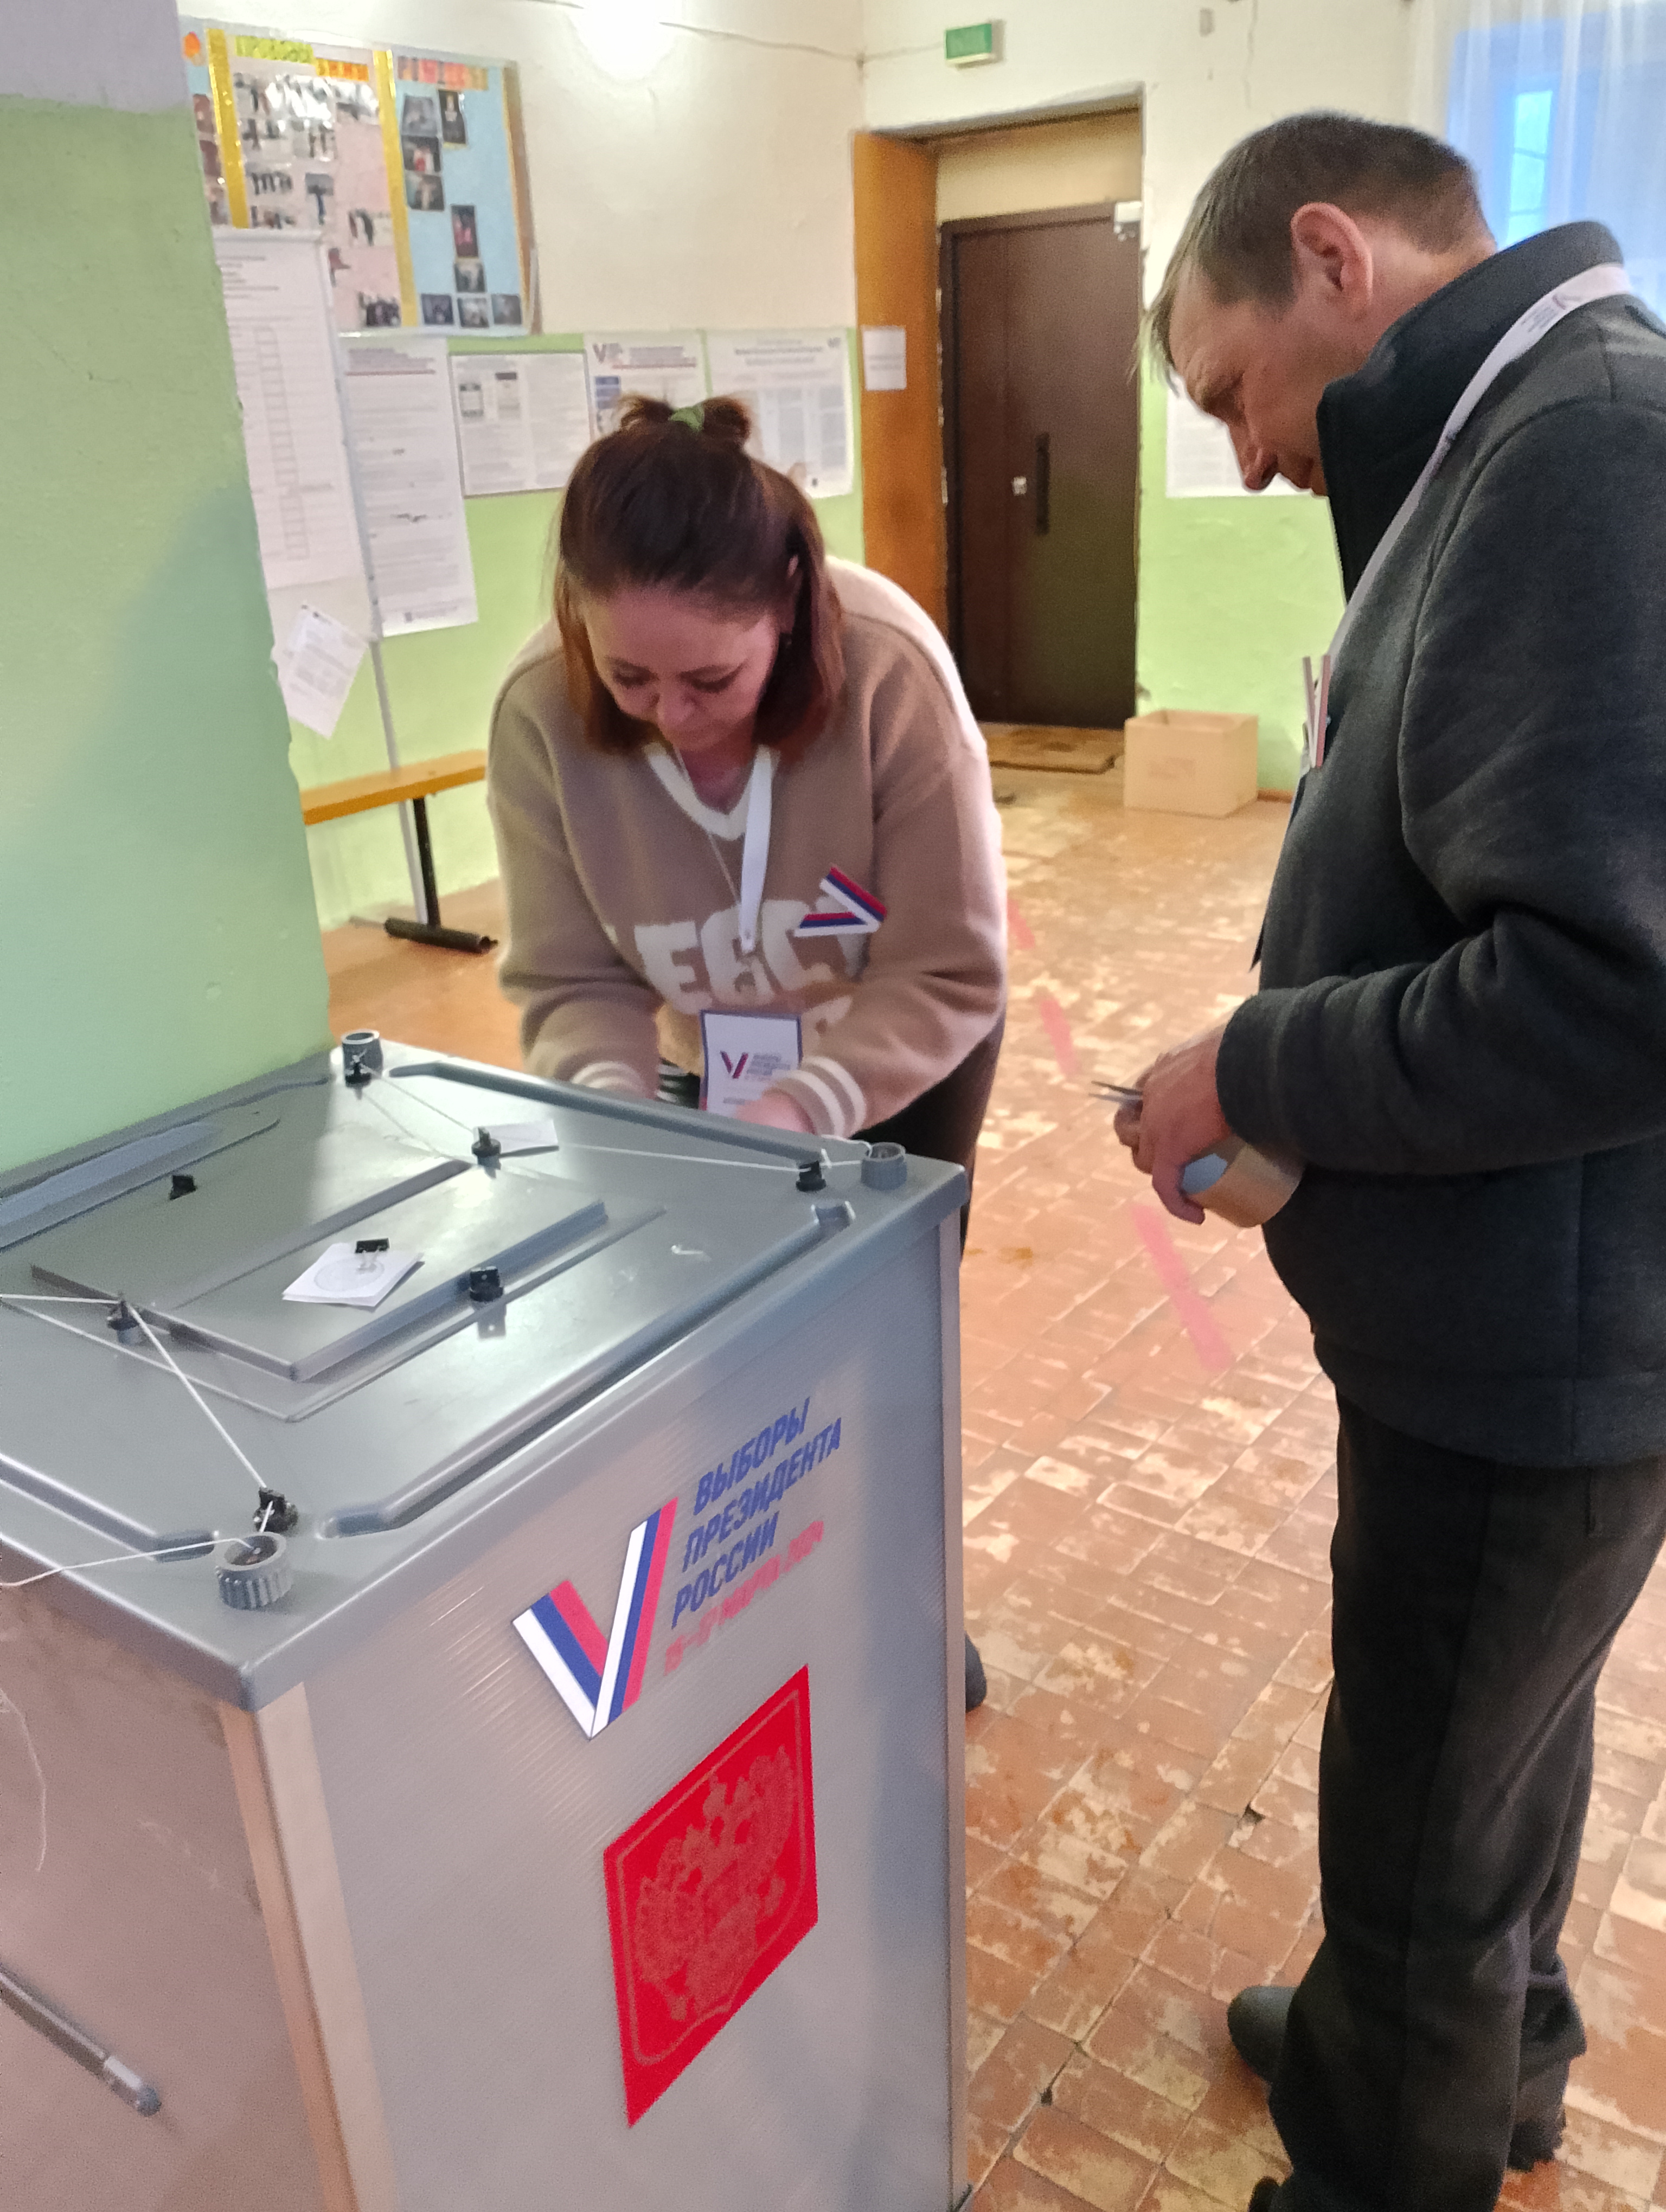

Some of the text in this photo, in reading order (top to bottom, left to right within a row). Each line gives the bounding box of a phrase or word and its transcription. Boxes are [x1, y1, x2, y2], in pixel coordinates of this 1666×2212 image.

[682, 1417, 841, 1573] ПРЕЗИДЕНТА
[693, 1396, 810, 1516] ВЫБОРЫ
[671, 1510, 780, 1630] РОССИИ
